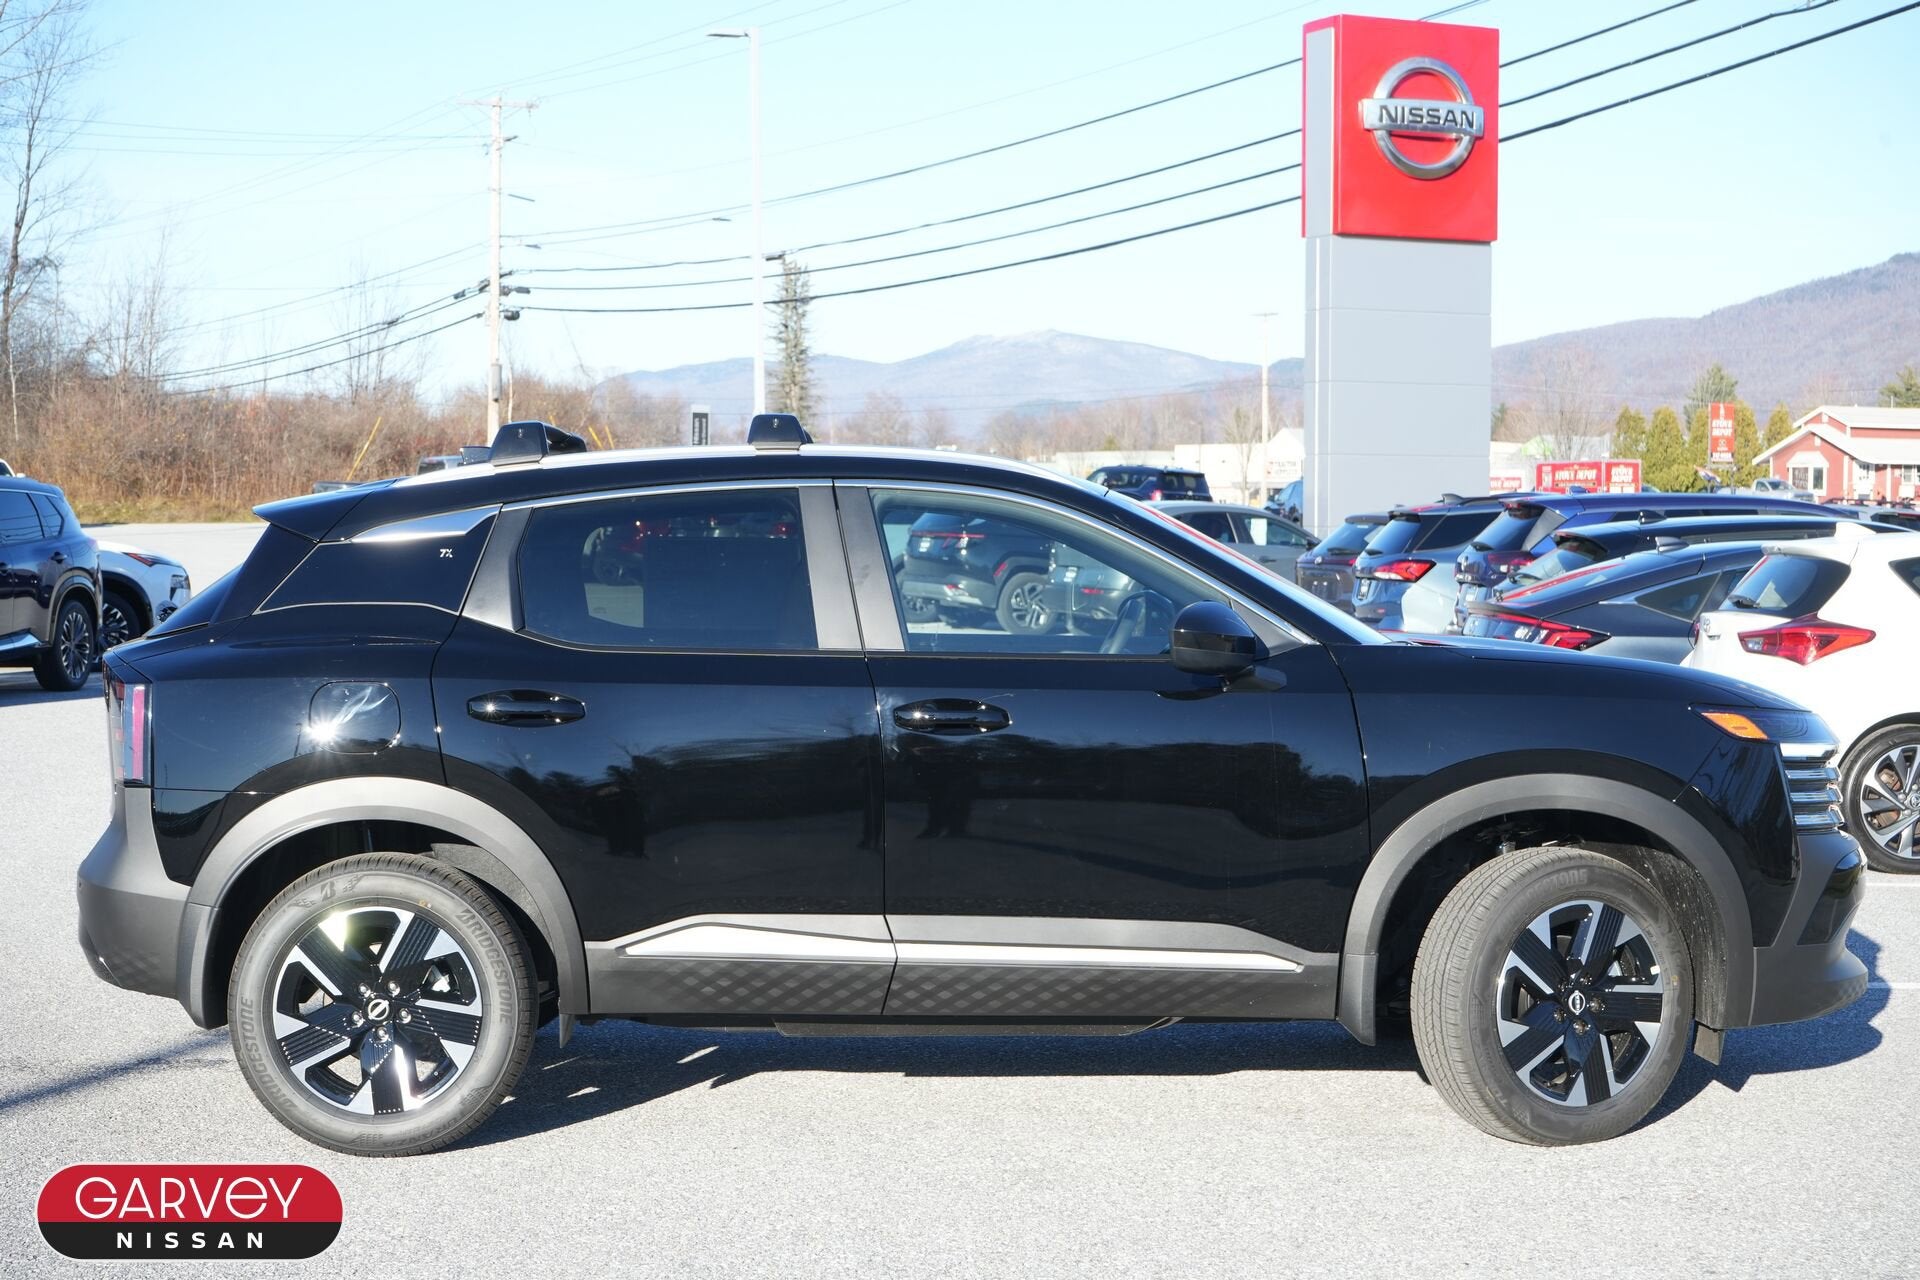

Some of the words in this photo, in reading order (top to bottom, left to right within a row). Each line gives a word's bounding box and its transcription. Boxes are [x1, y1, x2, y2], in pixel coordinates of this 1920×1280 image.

[1378, 104, 1475, 129] NISSAN
[1576, 469, 1597, 480] DEPOT
[455, 908, 513, 1024] BRIDGESTONE
[240, 997, 298, 1117] BRIDGESTONE
